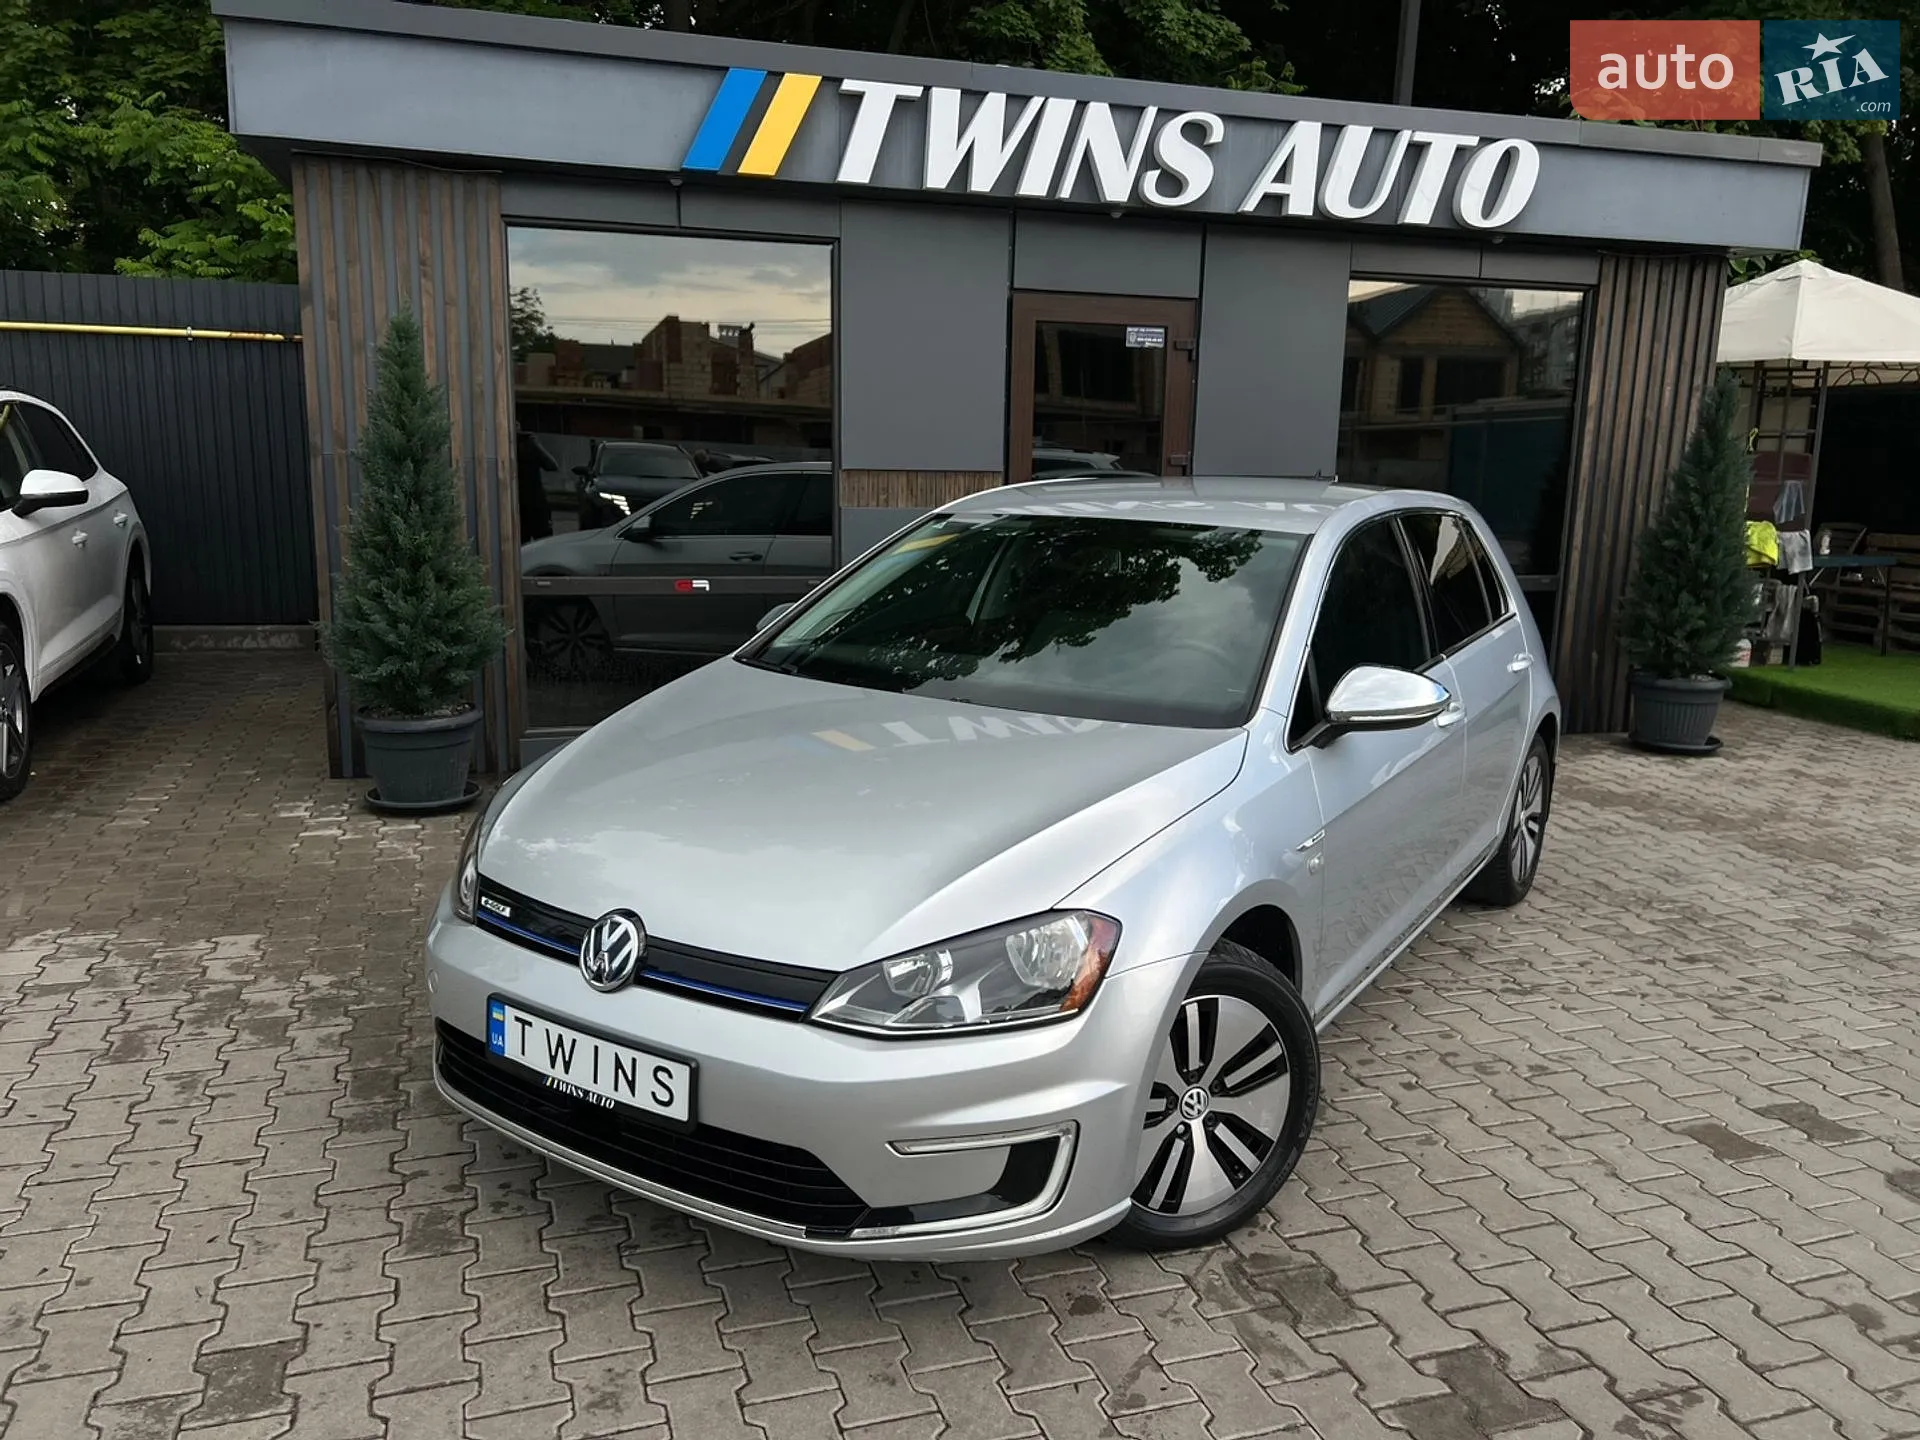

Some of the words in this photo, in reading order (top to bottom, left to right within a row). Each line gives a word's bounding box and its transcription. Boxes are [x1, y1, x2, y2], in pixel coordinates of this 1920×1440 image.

[836, 78, 1225, 208] TWINS
[1236, 120, 1540, 229] AUTO
[491, 1033, 504, 1048] UA
[514, 1016, 675, 1108] TWINS
[552, 1078, 585, 1099] TWINS
[585, 1091, 616, 1110] AUTO
